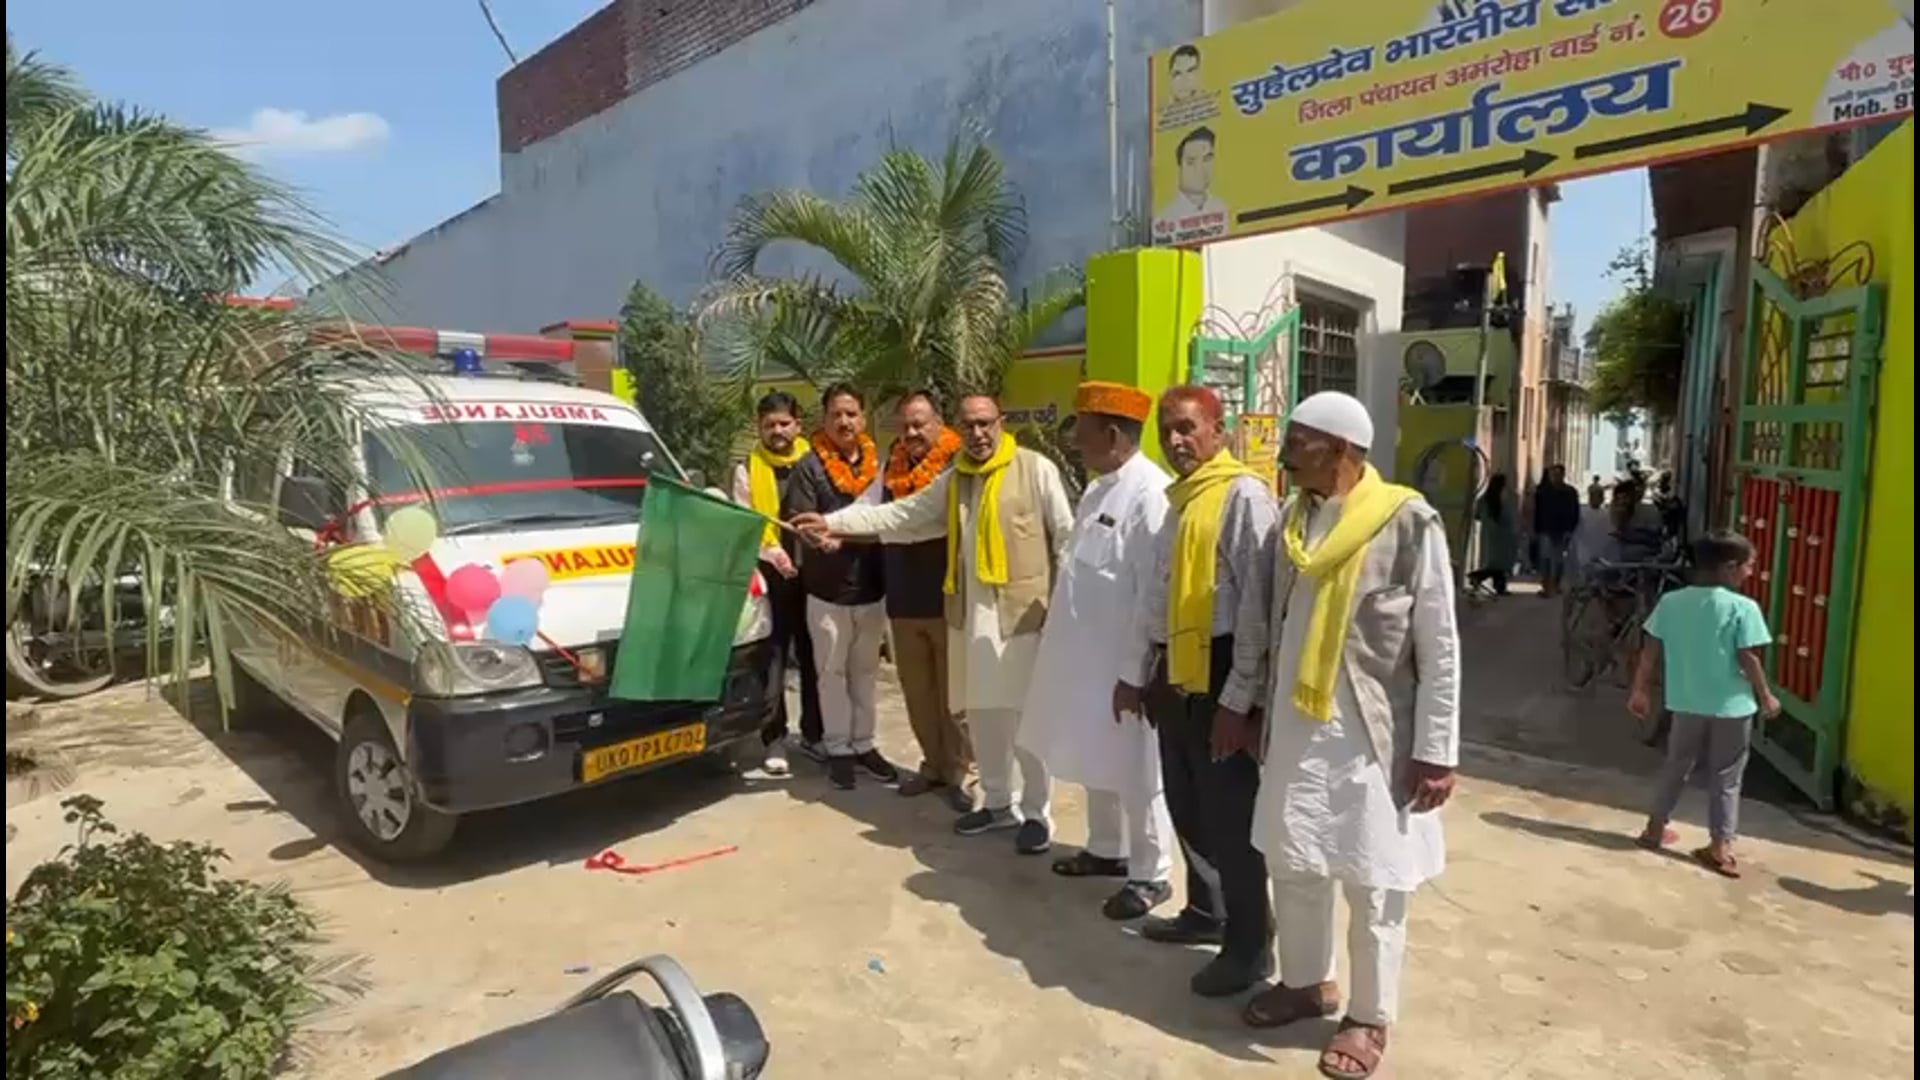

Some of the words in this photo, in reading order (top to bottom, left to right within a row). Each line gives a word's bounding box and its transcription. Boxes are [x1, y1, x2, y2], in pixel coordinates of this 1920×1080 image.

[1232, 47, 1375, 115] सुहेलदेव
[1385, 0, 1540, 62] भारतीय
[1299, 96, 1352, 124] जिला
[1360, 73, 1436, 106] पंचायत
[1551, 23, 1601, 58] वार्ड
[1667, 0, 1712, 32] 26
[1834, 98, 1888, 121] Mob.
[1288, 60, 1681, 181] कार्यालय
